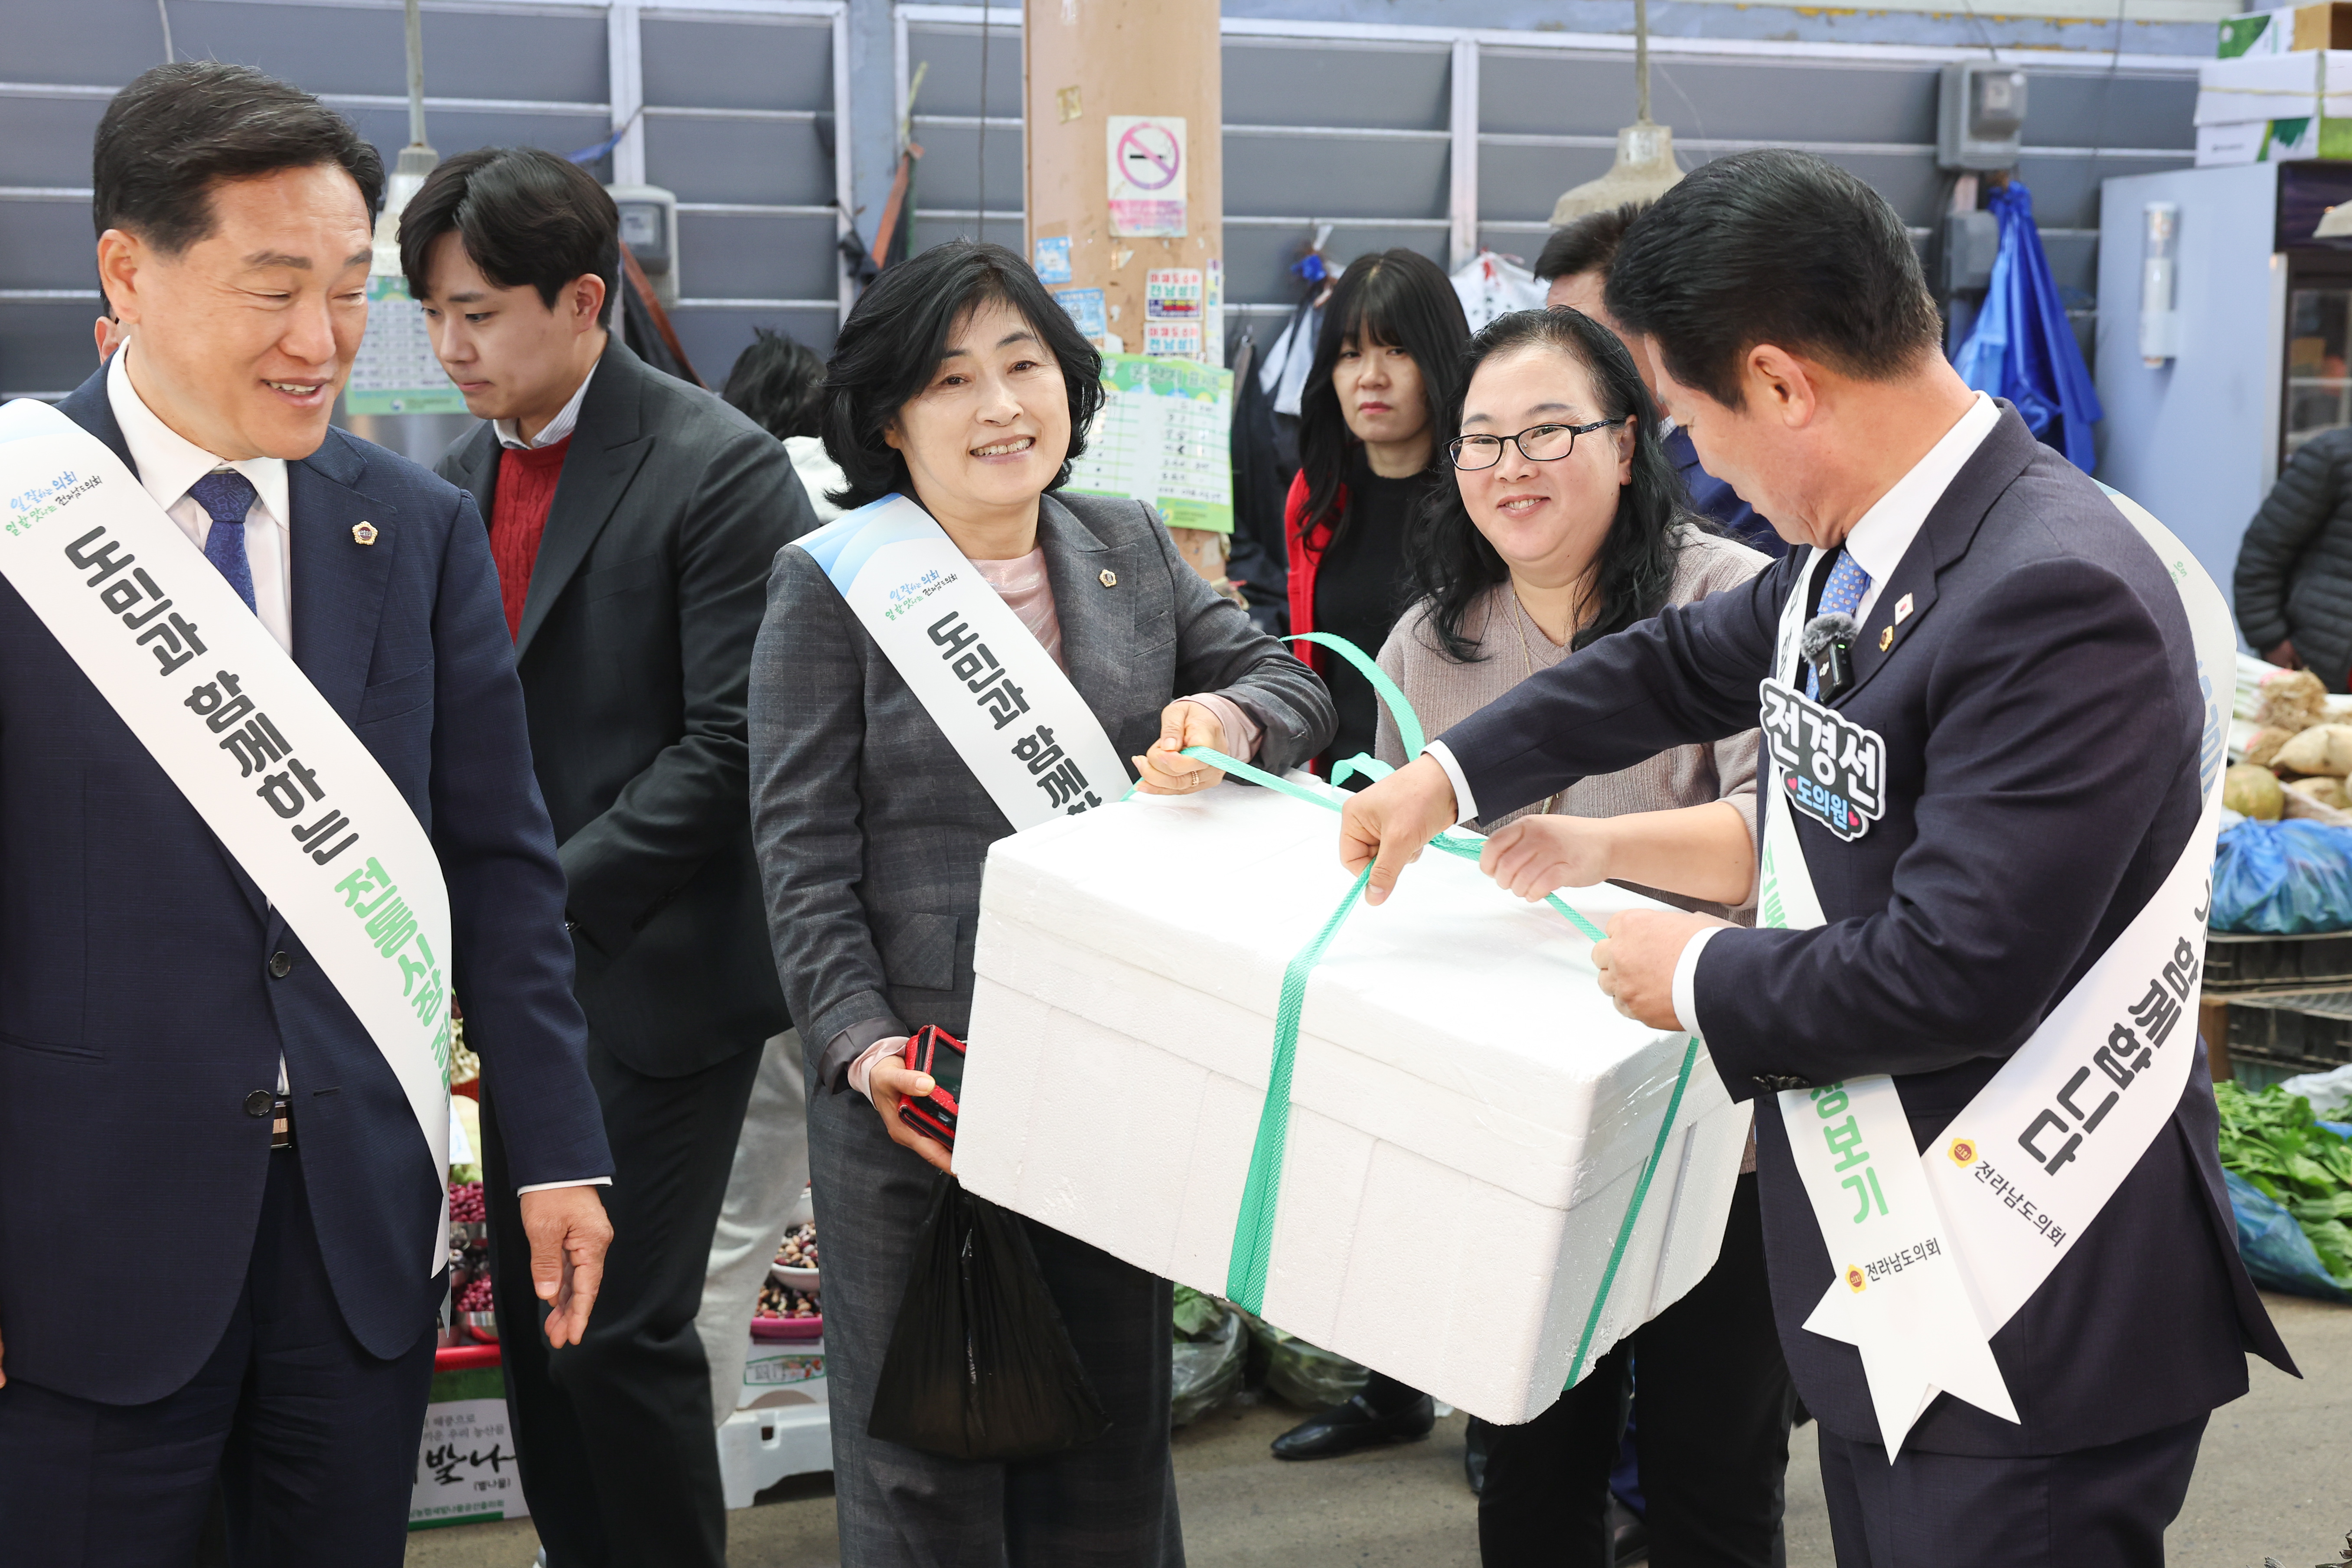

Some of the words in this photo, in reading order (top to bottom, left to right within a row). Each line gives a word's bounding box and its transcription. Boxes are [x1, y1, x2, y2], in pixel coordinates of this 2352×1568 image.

[52, 471, 78, 490] 의회
[55, 476, 103, 506] 전라남도의회
[921, 570, 940, 585] 의회
[922, 573, 958, 596] 전라남도의회
[927, 610, 1031, 730] 도민과
[65, 525, 208, 677] 도민과
[184, 670, 359, 866] 함께하는
[334, 857, 443, 1027] 전통시장
[1765, 690, 1876, 809] 전경선
[1796, 775, 1848, 831] 도의원
[2018, 936, 2199, 1176] 함께합니다
[1974, 1160, 2067, 1248] 전라남도의회
[1865, 1237, 1941, 1282] 전라남도의회
